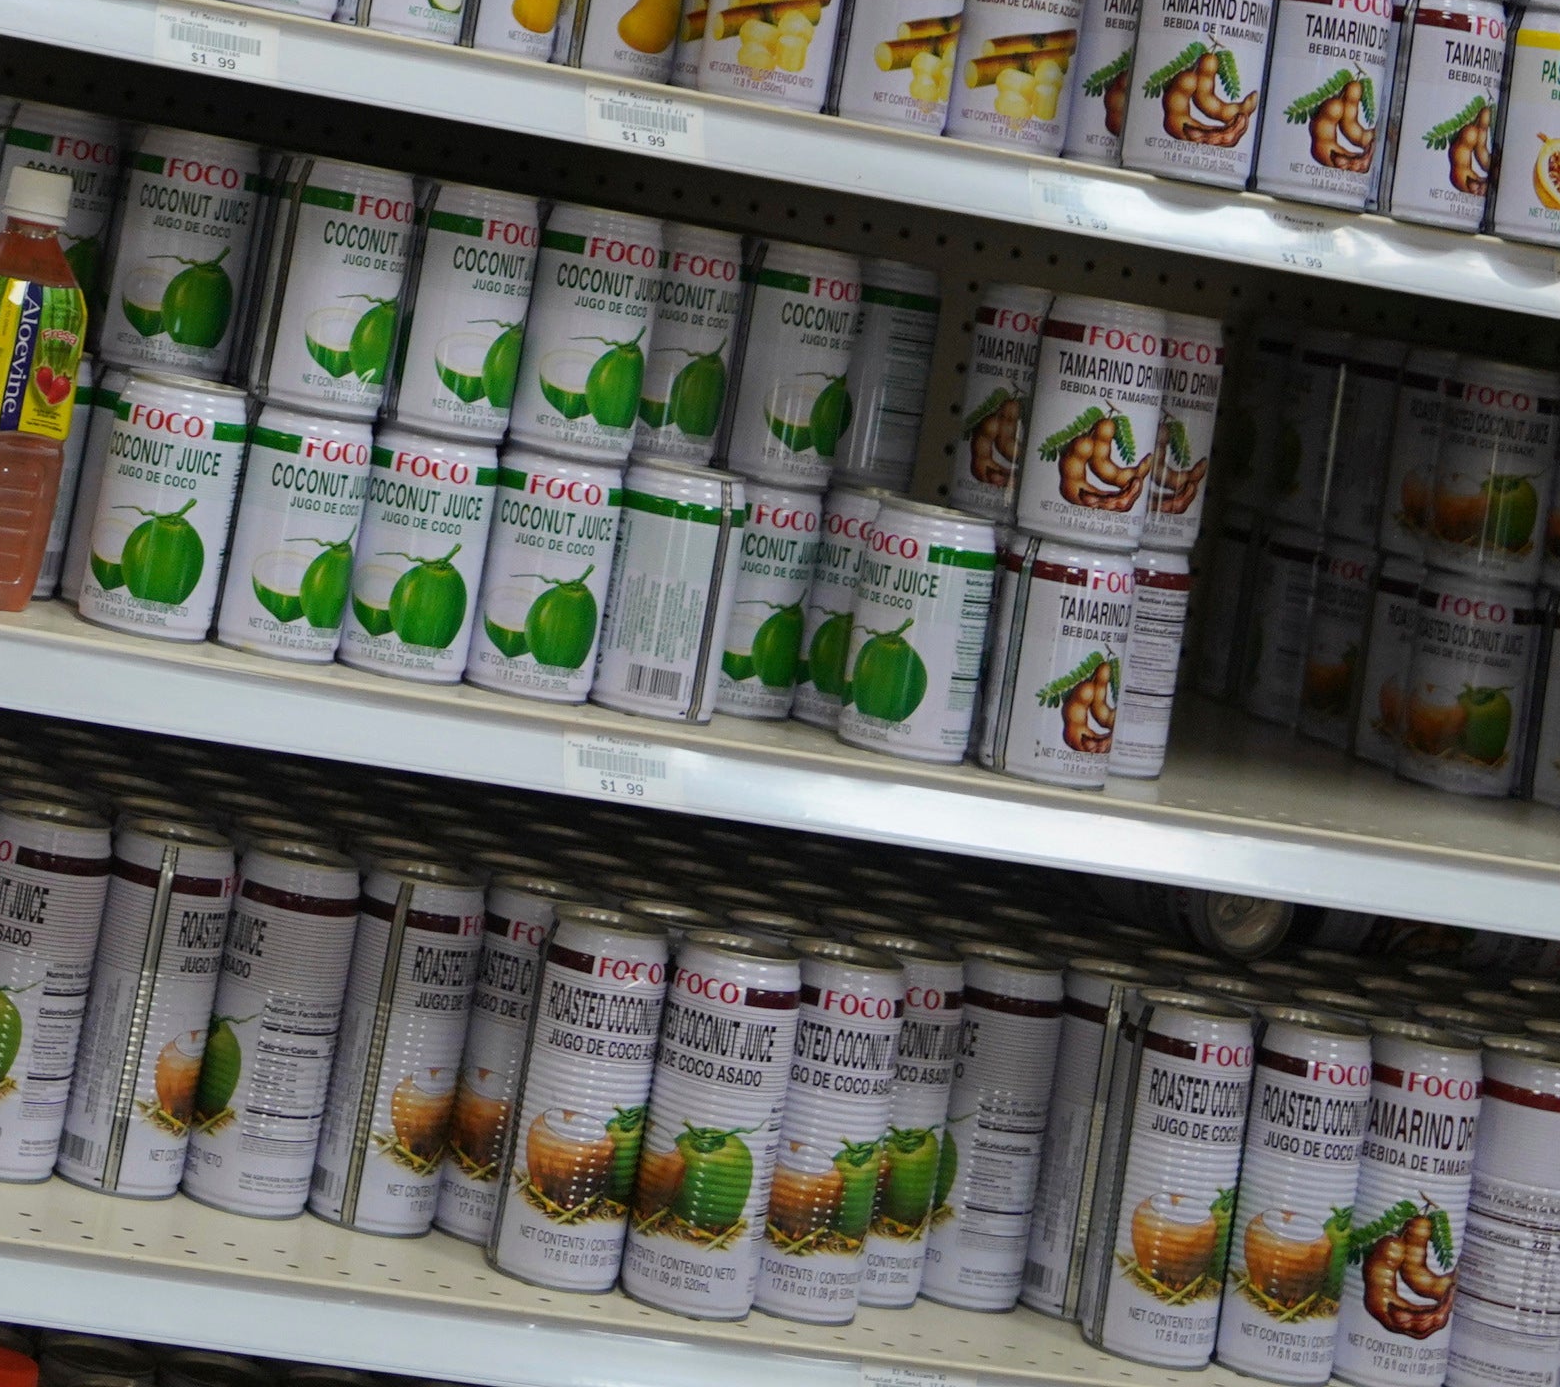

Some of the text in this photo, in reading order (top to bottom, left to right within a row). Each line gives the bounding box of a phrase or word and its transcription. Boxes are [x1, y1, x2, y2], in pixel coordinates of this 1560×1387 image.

[1305, 13, 1378, 48] TAMARIND
[168, 157, 239, 189] FOCO
[139, 183, 213, 218] COCONUT
[556, 262, 633, 297] COCONUT
[40, 326, 78, 347] Fresa
[0, 295, 42, 415] Aloevine
[1058, 350, 1133, 385] TAMARIND
[129, 403, 205, 439] FOCO
[109, 429, 222, 478] COCONUT JUICE
[395, 452, 469, 485] FOCO
[272, 462, 348, 497] COCONUT
[370, 477, 440, 515] COCONUT
[529, 474, 602, 506] FOCO
[501, 498, 574, 536] COCONUT
[675, 968, 740, 1005] FOCO
[586, 1036, 606, 1055] DE
[679, 1052, 763, 1088] COCO ASADO
[1148, 1067, 1211, 1117] ROASTED
[1263, 1131, 1300, 1154] JUGO
[1361, 1141, 1408, 1168] BEBIDA
